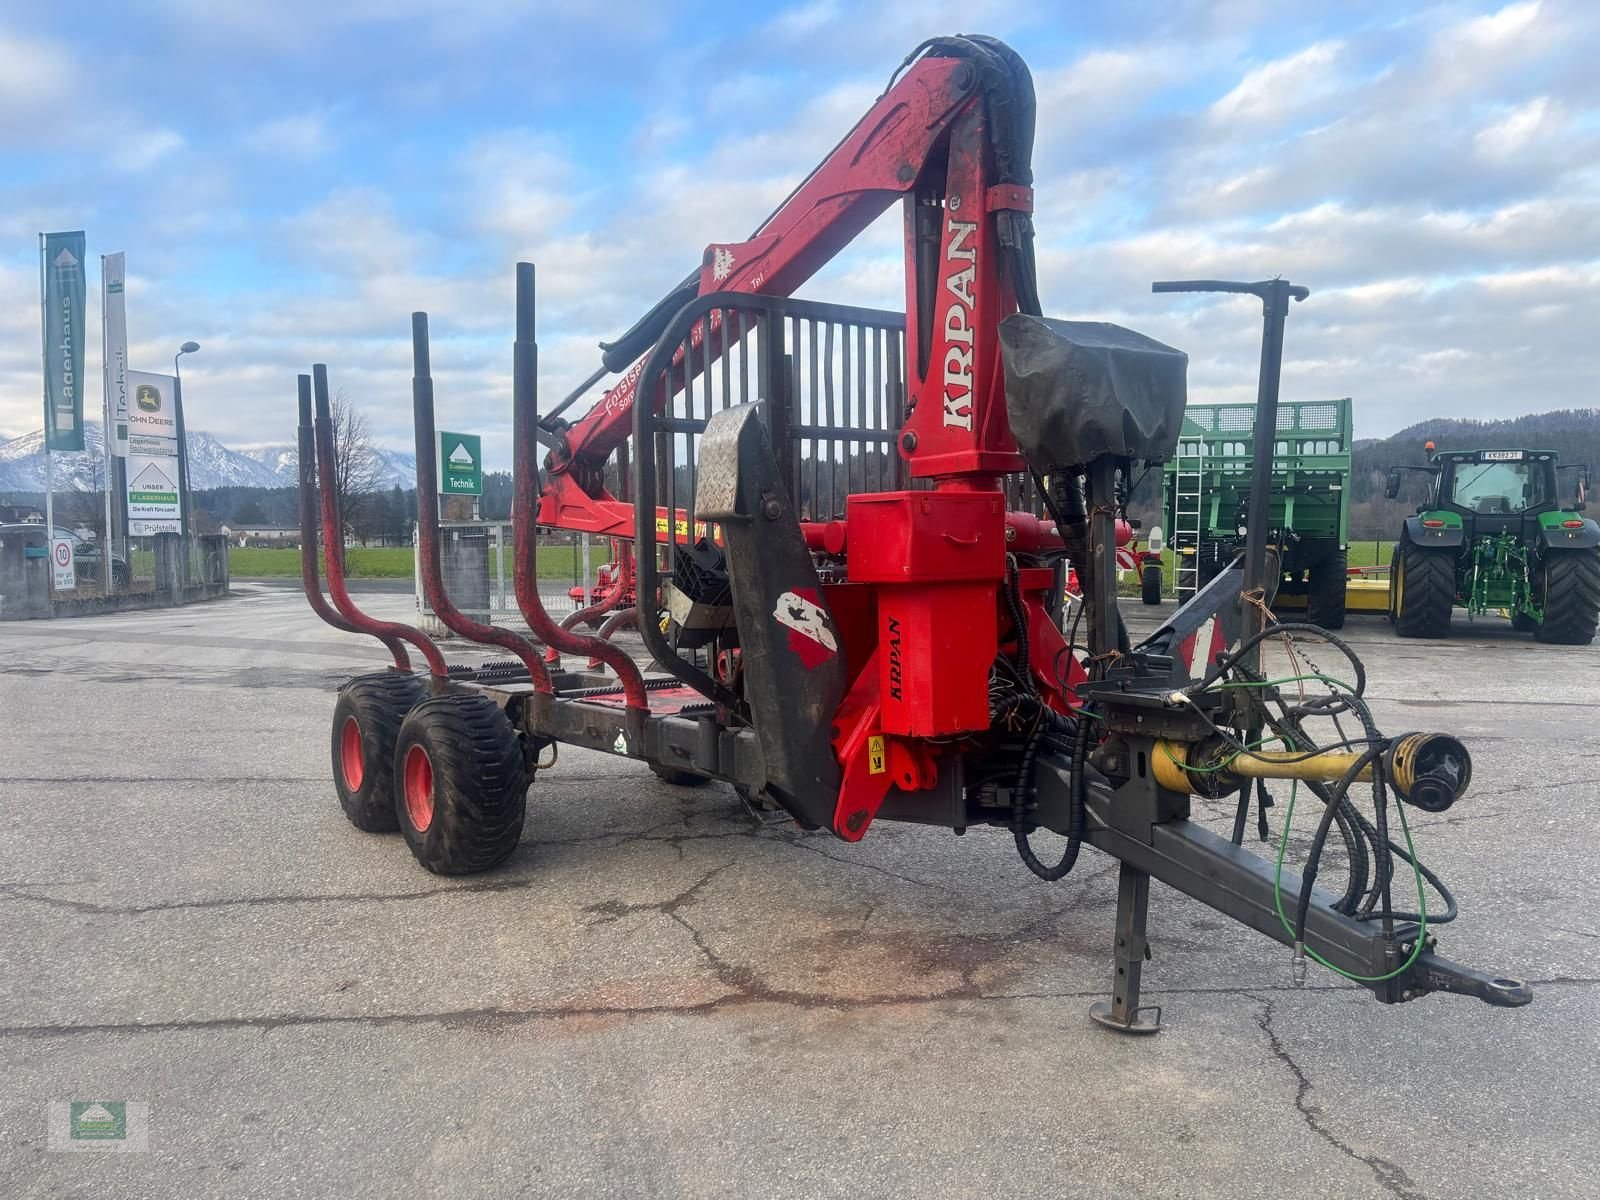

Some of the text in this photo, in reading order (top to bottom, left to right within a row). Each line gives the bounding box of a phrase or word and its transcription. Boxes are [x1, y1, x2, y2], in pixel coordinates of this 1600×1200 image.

[943, 219, 977, 432] KRPAN
[57, 296, 74, 409] Lagerhaus
[149, 416, 175, 426] DEERE
[449, 477, 475, 489] Technik
[144, 524, 177, 532] Prüfstelle
[59, 549, 67, 560] 10
[888, 616, 903, 703] KRPAN
